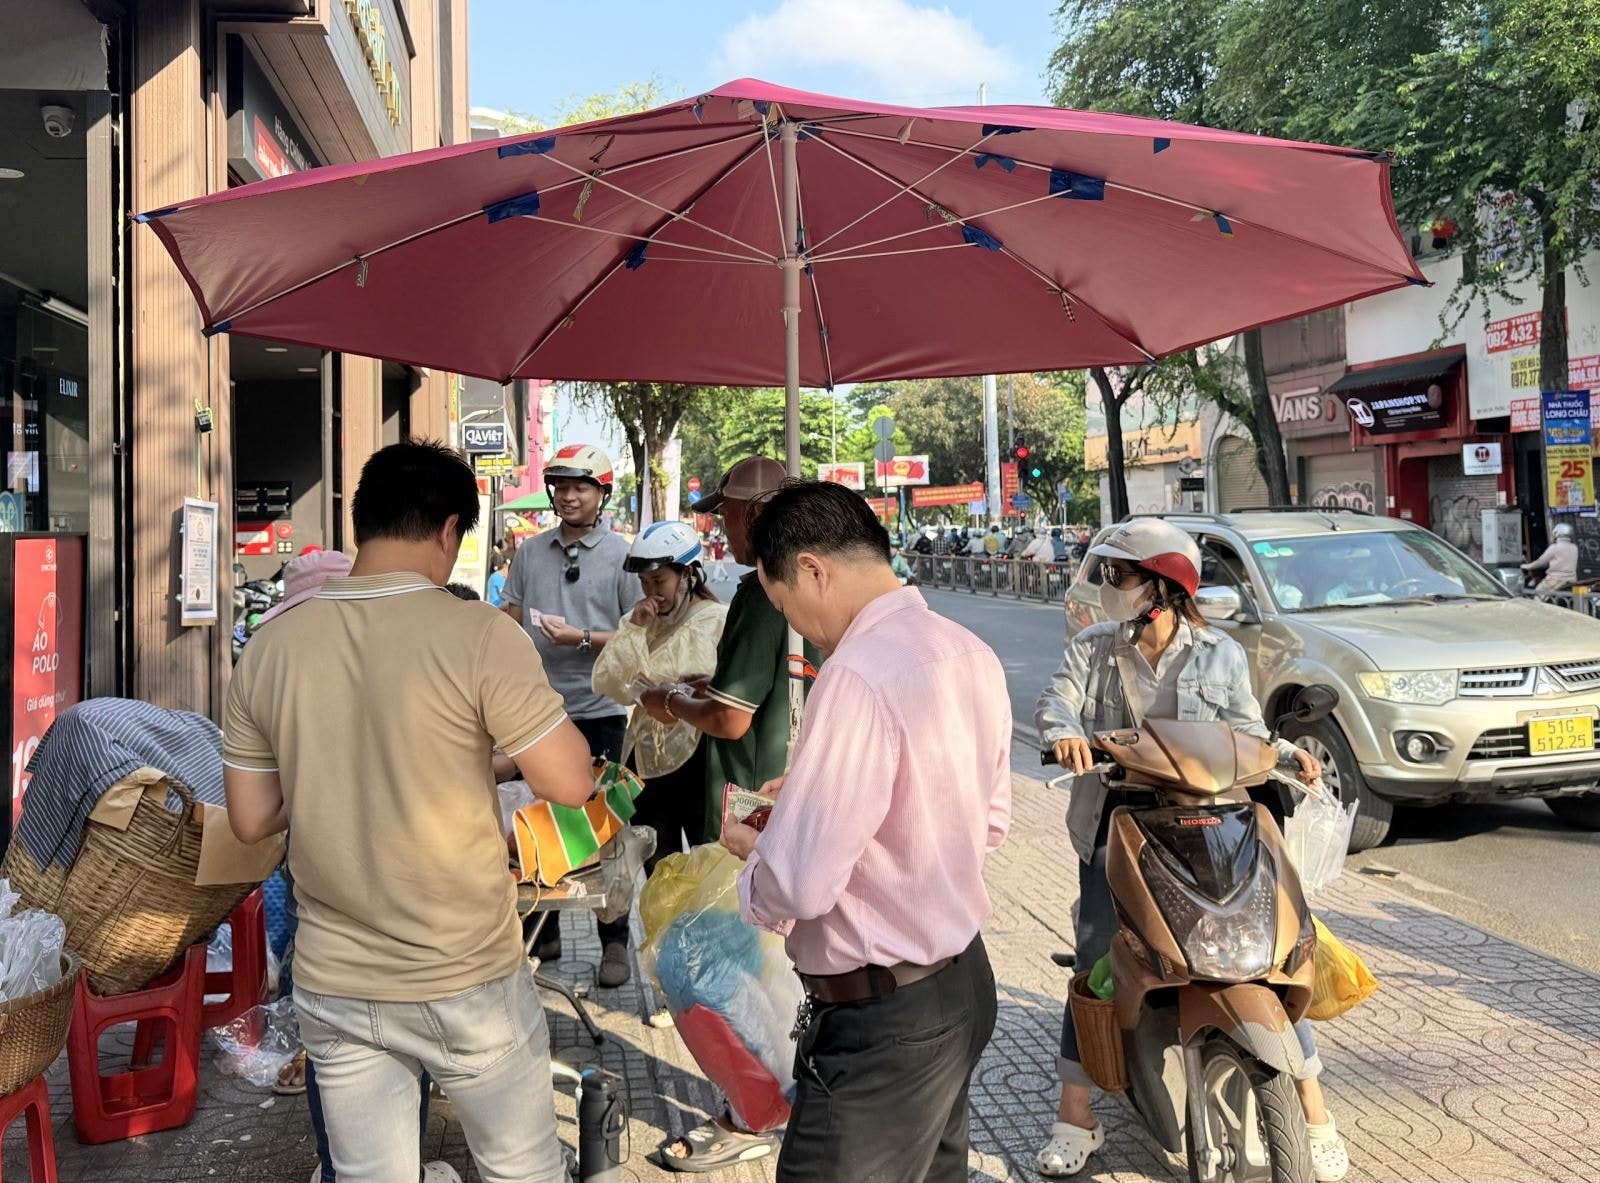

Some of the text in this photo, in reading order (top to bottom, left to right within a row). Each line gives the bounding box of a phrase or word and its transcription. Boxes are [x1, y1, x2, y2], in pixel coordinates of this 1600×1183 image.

[1487, 330, 1508, 350] 092
[1511, 323, 1533, 343] 432
[60, 378, 78, 398] ELIXIR
[1271, 386, 1321, 423] VANS
[1370, 394, 1428, 411] JAPANSHOP.VN
[1548, 401, 1562, 409] NHÀ
[1545, 410, 1567, 419] LONG
[1568, 408, 1588, 418] CHÂU
[32, 628, 48, 652] ÁO
[32, 652, 59, 675] POLO
[27, 695, 38, 712] Giá
[1548, 719, 1575, 735] 51G
[1537, 734, 1586, 752] 512.25
[1183, 817, 1222, 826] HONDA
